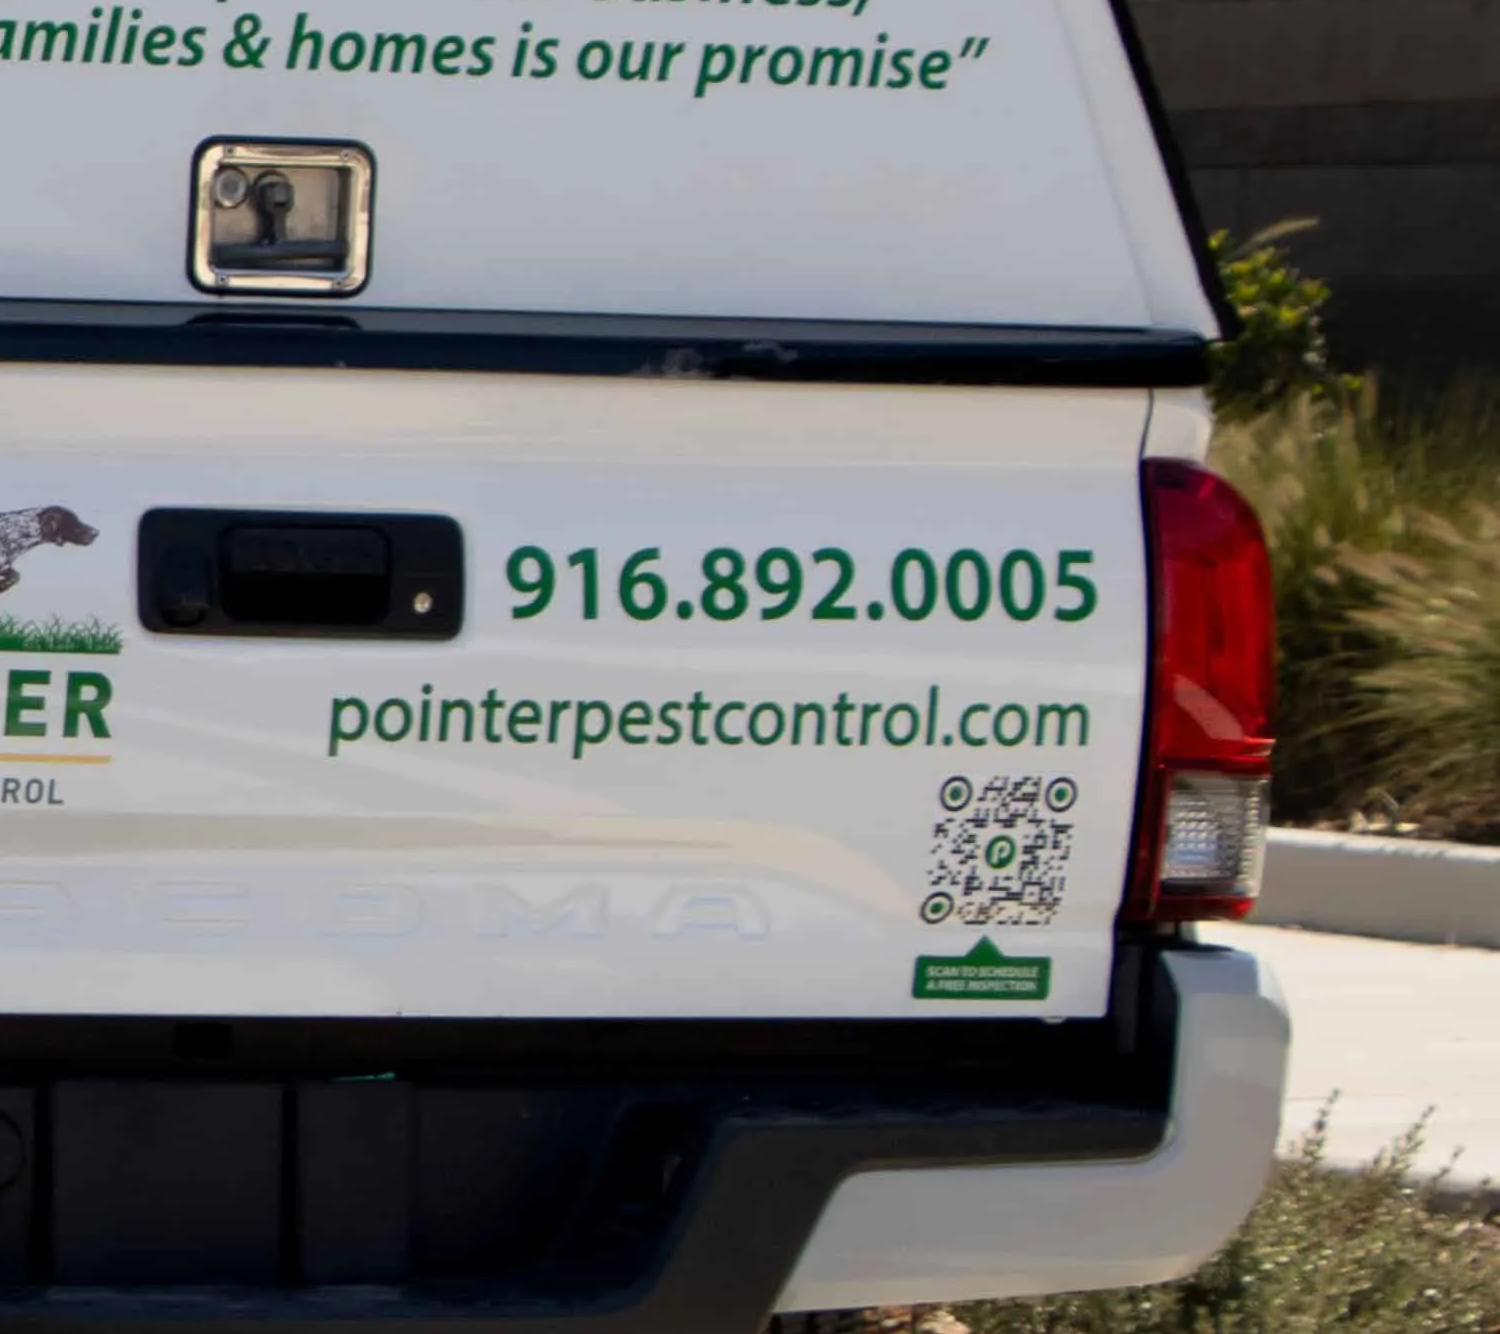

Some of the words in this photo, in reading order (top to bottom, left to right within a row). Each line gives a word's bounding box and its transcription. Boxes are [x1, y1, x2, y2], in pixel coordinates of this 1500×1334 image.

[222, 13, 270, 69] &
[285, 12, 494, 76] homes
[509, 22, 558, 79] is
[576, 34, 684, 83] our
[694, 33, 990, 98] promise”
[505, 546, 1099, 622] 916.892.0005
[328, 684, 1090, 759] pointerpestcontrol.com
